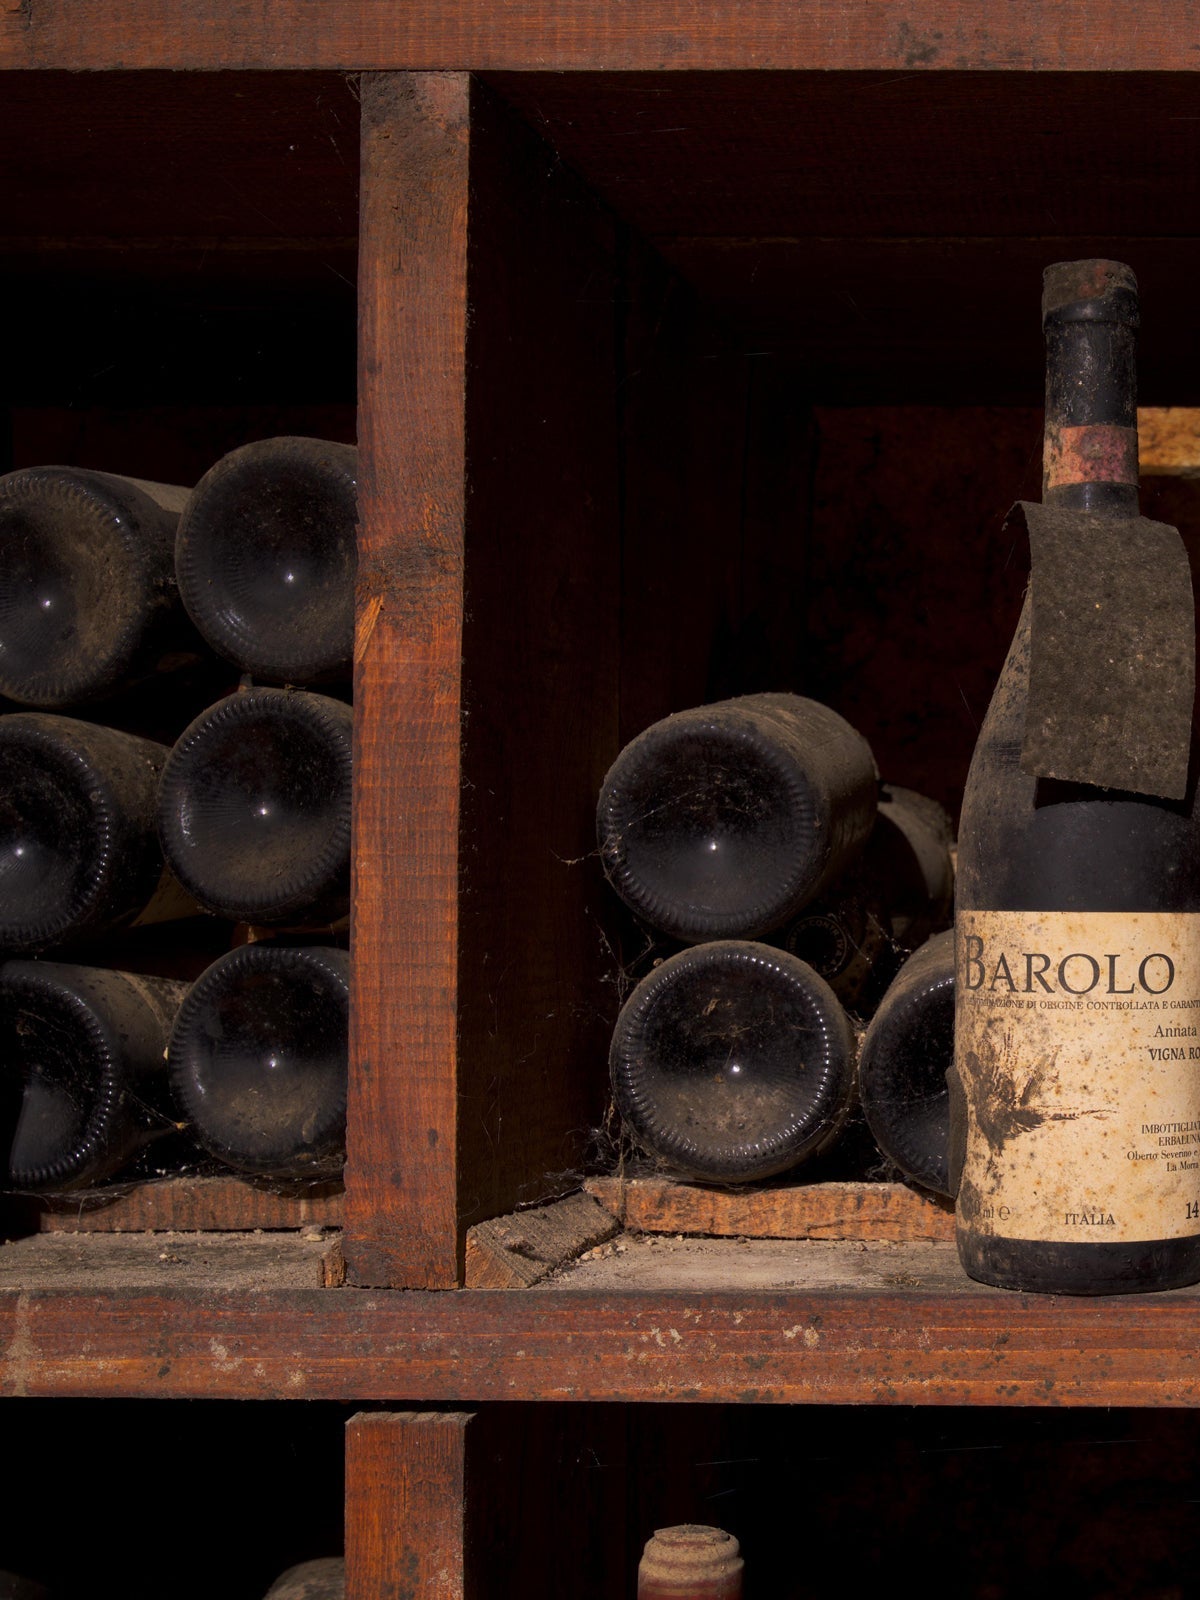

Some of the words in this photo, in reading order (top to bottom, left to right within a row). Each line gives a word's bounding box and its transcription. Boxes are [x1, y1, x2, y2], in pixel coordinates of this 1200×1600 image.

[964, 935, 1175, 995] BAROLO
[1026, 1000, 1037, 1010] DI
[1040, 1000, 1084, 1010] ORIGINE
[1086, 1001, 1160, 1011] CONTROLLATA
[1162, 1001, 1169, 1010] E
[1154, 1024, 1197, 1038] Annata
[1149, 1047, 1186, 1061] VIGNA
[1158, 1134, 1200, 1147] ERBALUNA
[1126, 1150, 1158, 1161] Oberto
[1161, 1149, 1192, 1160] Severino
[1166, 1161, 1177, 1172] La
[1179, 1160, 1199, 1171] Morra
[1185, 1199, 1199, 1220] 14
[1064, 1213, 1116, 1226] ITALIA
